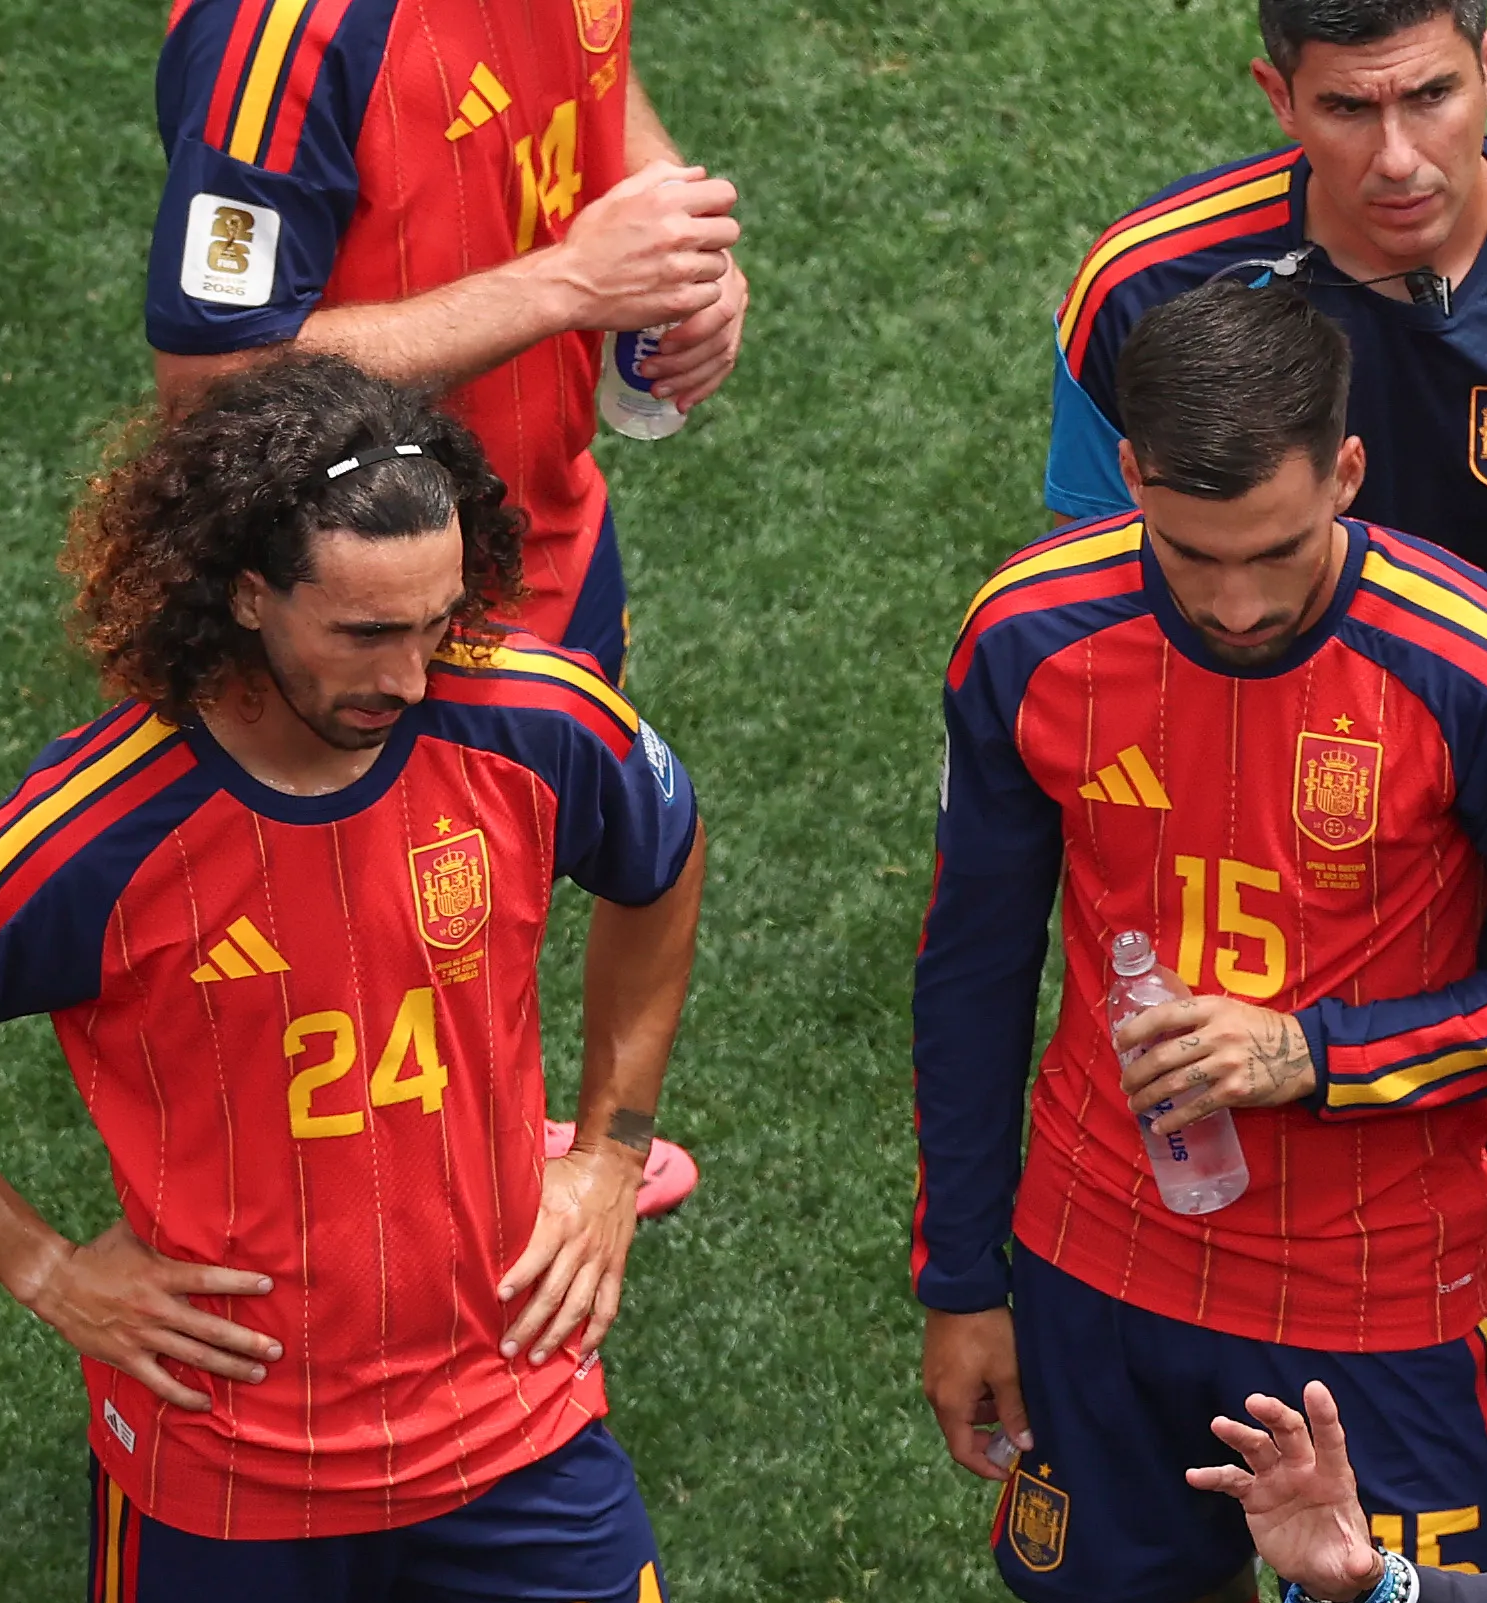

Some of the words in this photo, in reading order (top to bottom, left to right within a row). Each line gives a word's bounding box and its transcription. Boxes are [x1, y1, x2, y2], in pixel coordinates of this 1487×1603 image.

[515, 100, 583, 252] 14
[202, 281, 246, 297] 2026
[1176, 855, 1287, 999] 15
[283, 988, 449, 1139] 24
